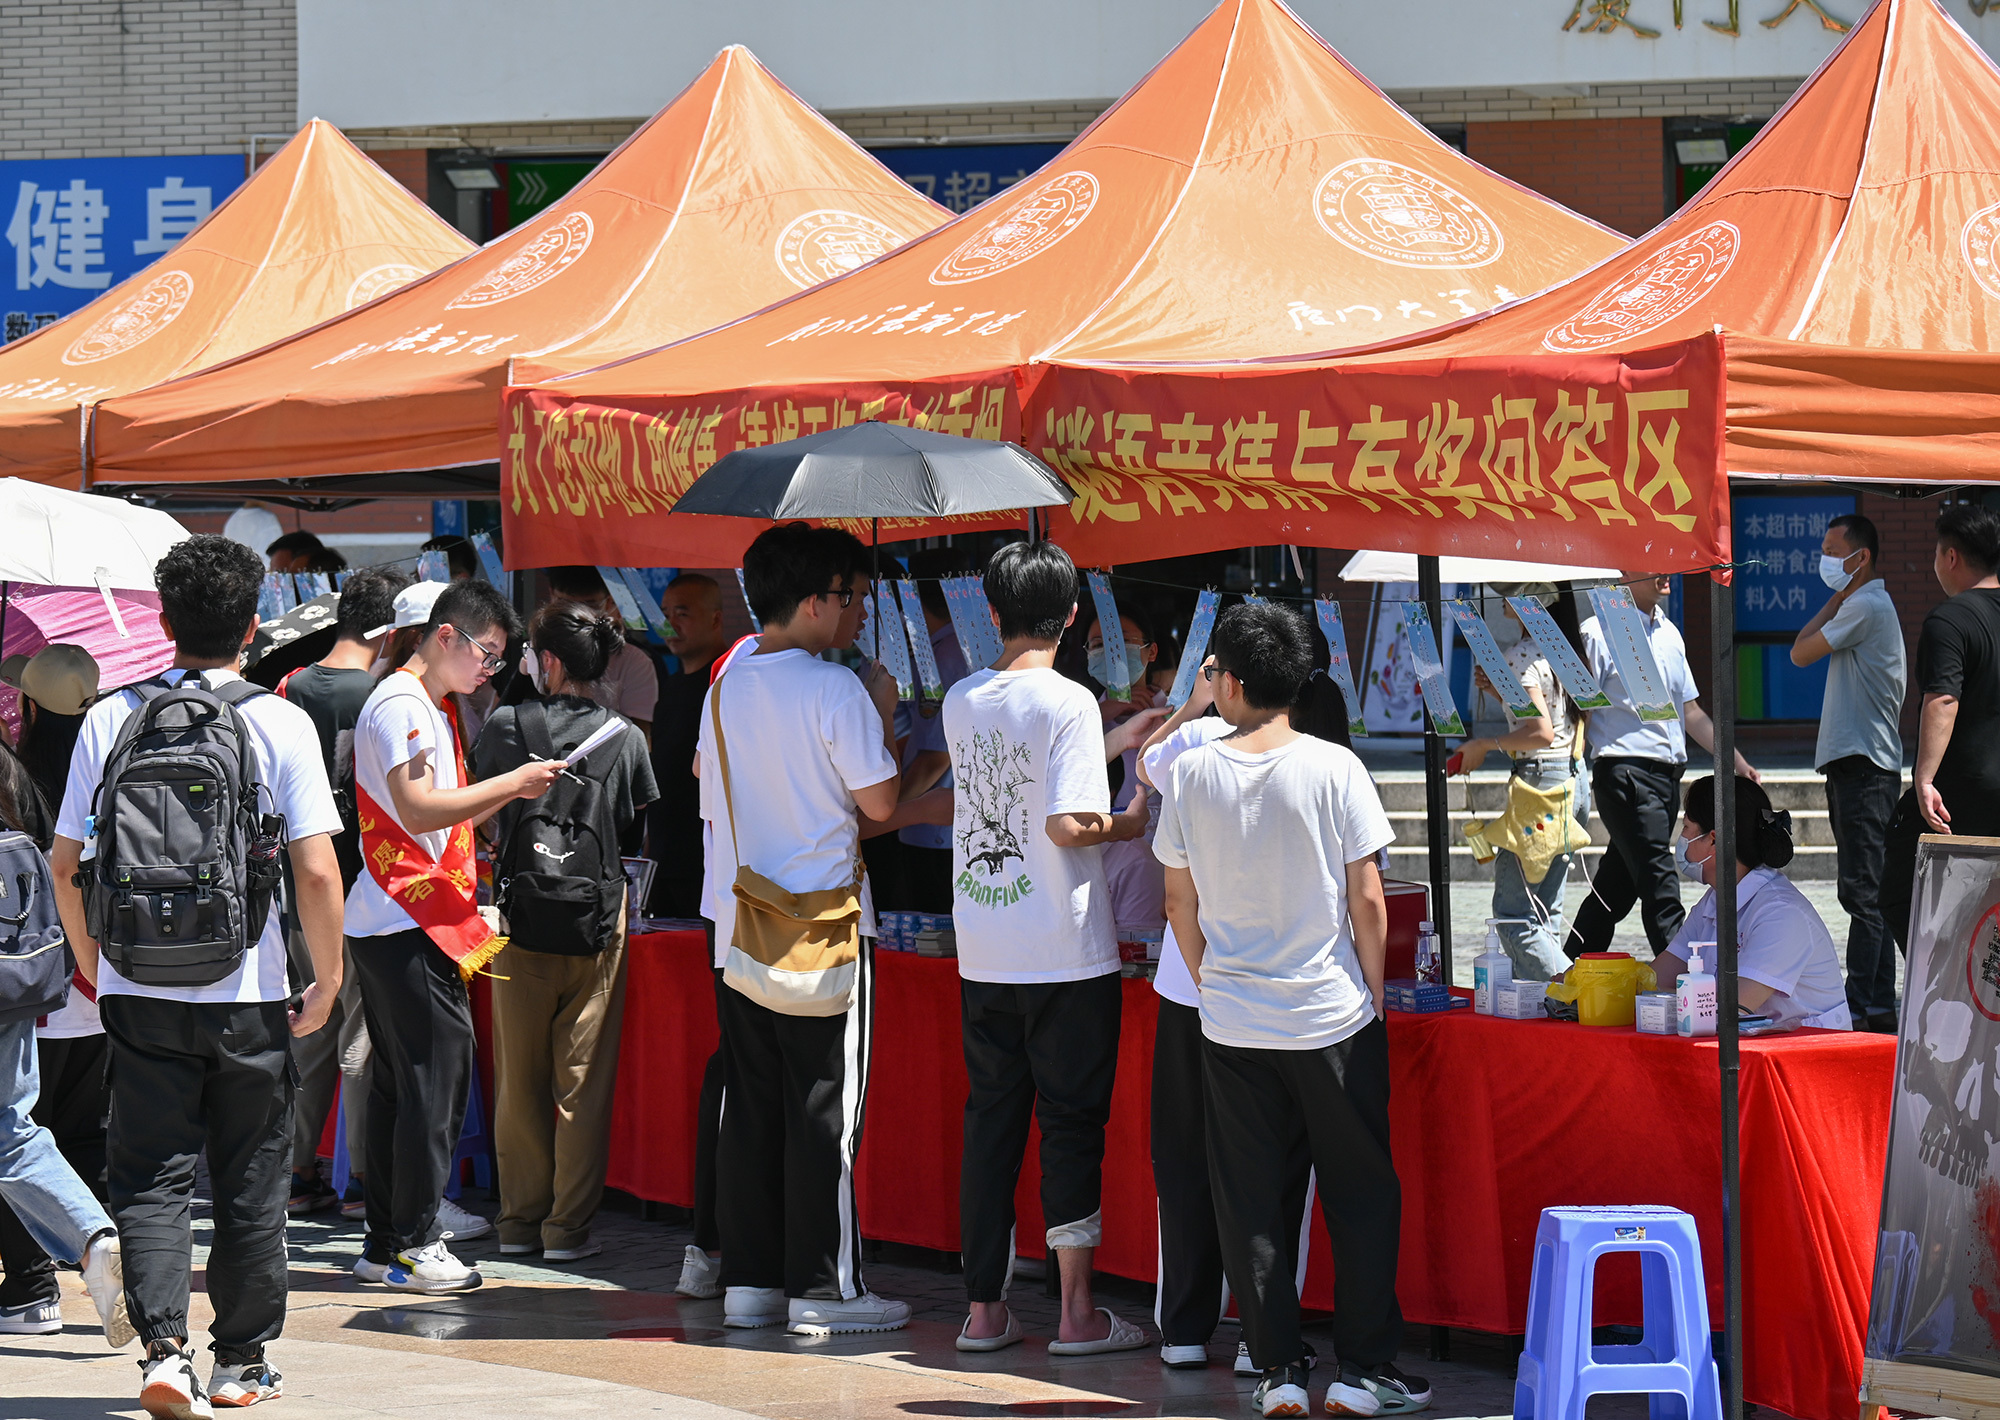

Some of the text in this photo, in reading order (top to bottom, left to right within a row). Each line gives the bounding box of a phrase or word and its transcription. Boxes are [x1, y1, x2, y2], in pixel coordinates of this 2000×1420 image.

[1409, 231, 1449, 242] 2003
[1369, 244, 1434, 262] UNIVERSITY
[1647, 290, 1699, 326] COLLEGE
[1745, 512, 1843, 539] 本超市谢
[1745, 586, 1806, 611] 料入内
